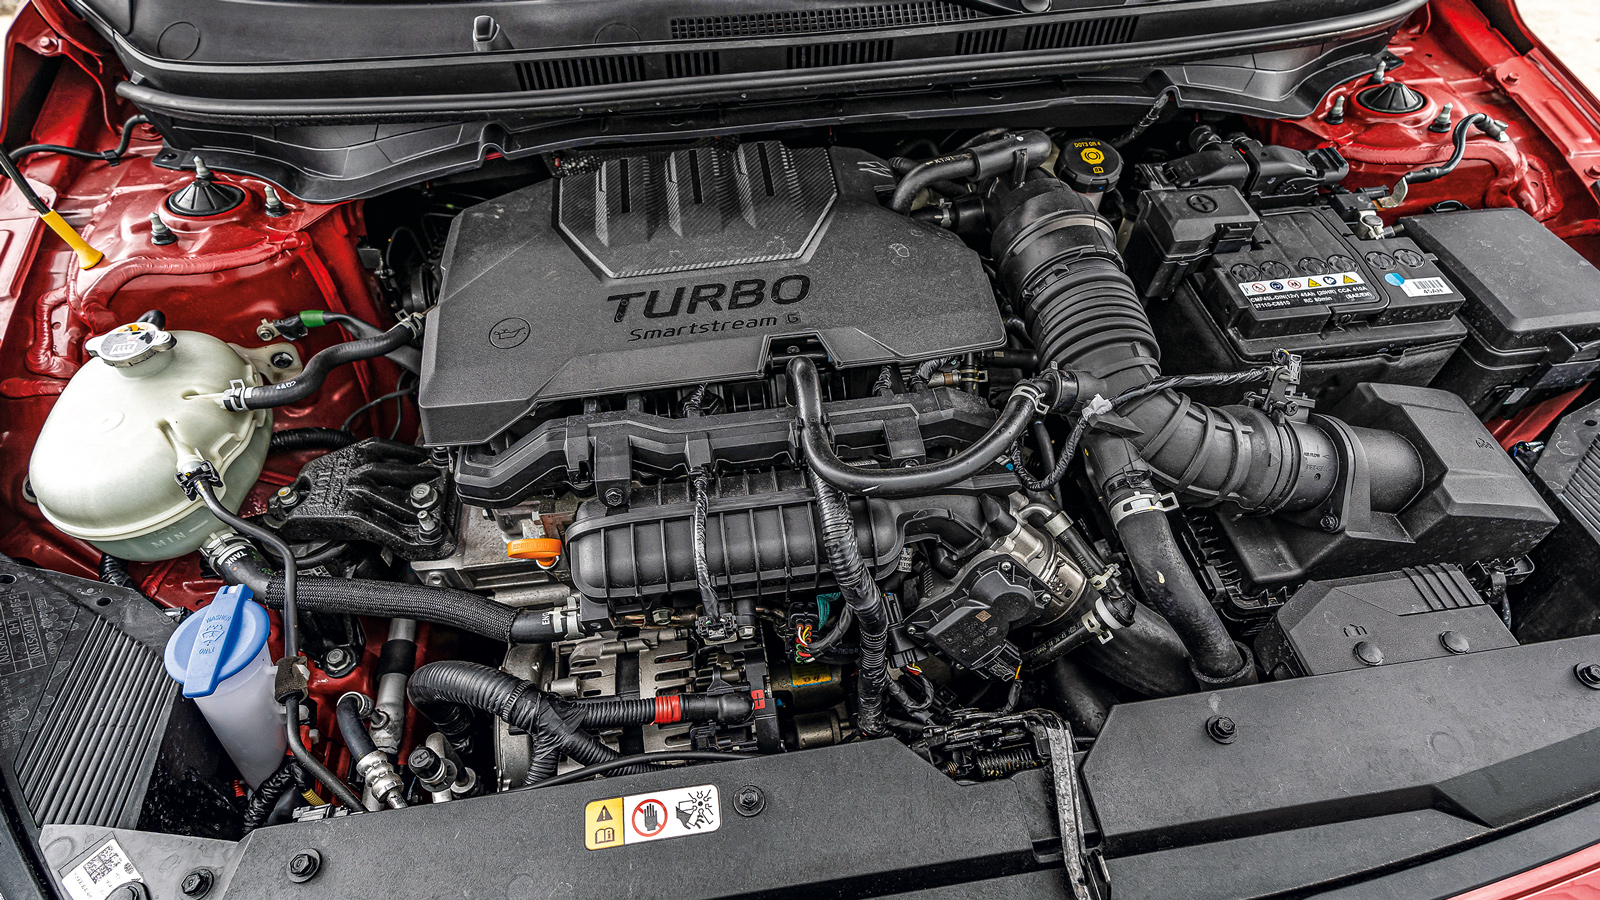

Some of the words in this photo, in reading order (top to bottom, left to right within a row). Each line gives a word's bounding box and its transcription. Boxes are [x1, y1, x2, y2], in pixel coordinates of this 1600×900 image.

[607, 274, 811, 323] TURBO
[628, 315, 777, 342] Smartstream
[786, 312, 800, 324] G
[151, 531, 187, 549] MIN
[224, 550, 248, 567] TANK
[7, 619, 20, 635] LHD
